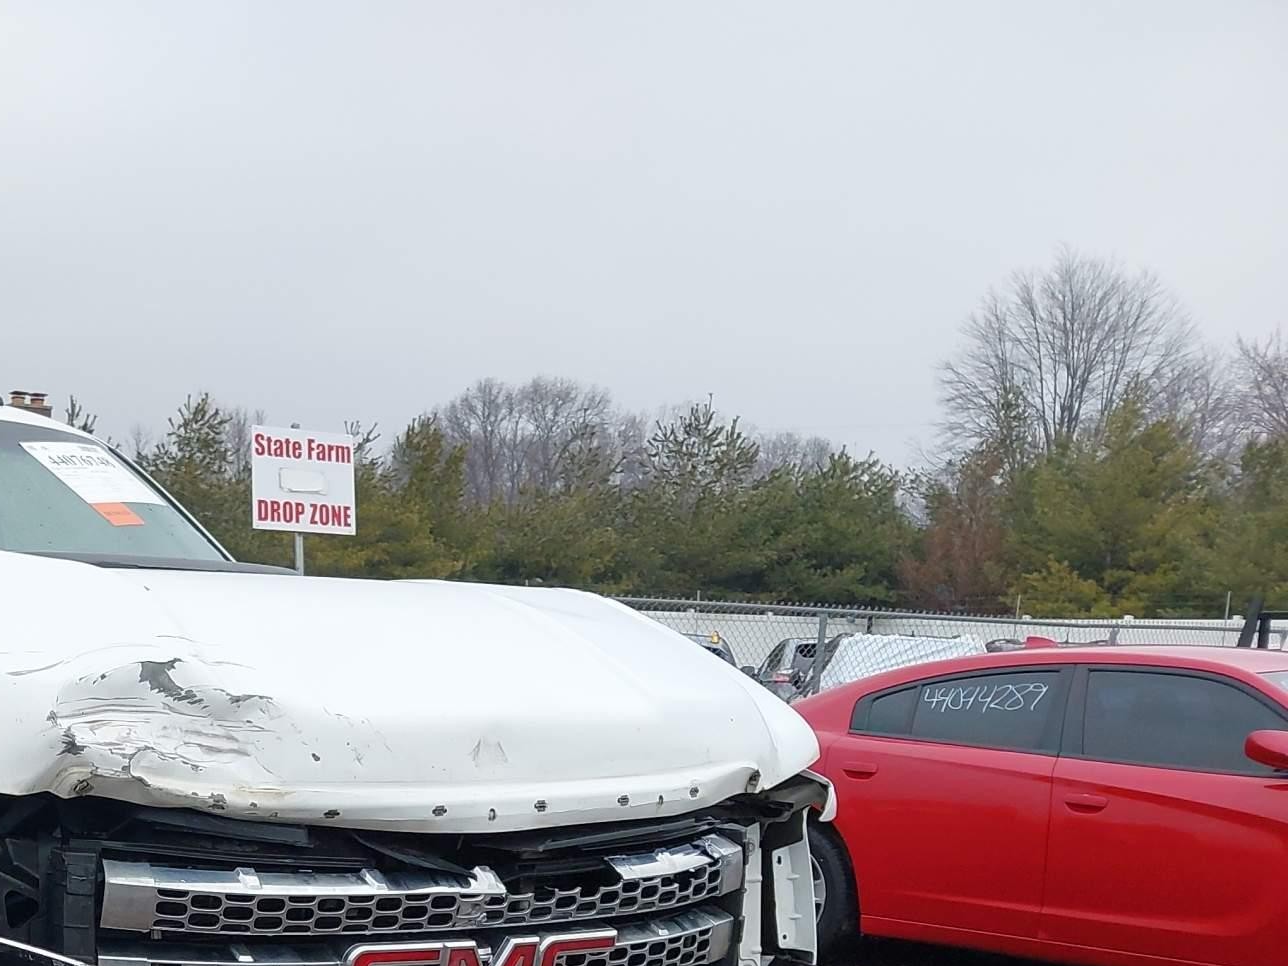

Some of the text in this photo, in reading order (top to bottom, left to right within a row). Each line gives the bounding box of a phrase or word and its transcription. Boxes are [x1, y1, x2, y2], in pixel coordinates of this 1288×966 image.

[254, 433, 352, 464] State Farm
[257, 499, 352, 527] DROP ZONE
